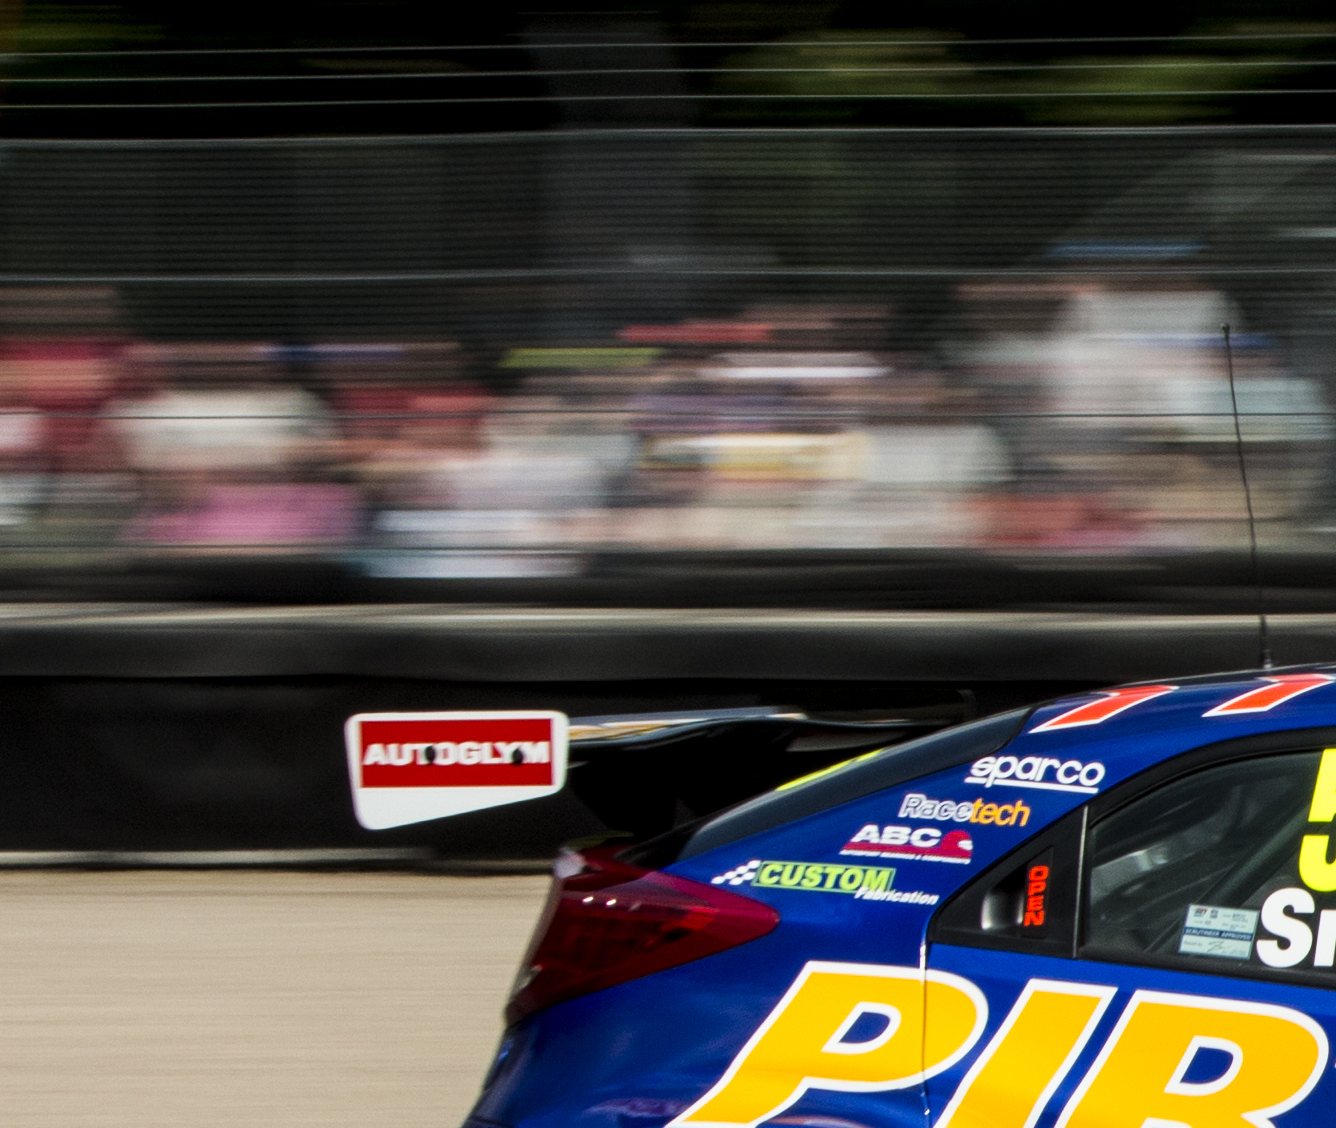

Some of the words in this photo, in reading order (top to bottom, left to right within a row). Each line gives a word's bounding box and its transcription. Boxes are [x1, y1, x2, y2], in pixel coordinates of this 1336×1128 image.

[363, 741, 551, 766] AUTOGLYM
[969, 756, 1105, 788] sparco
[898, 793, 1033, 827] Racetech
[850, 824, 943, 848] ABC
[758, 863, 889, 893] CUSTOM
[853, 886, 940, 906] Fabrication
[1024, 866, 1049, 927] OPEN
